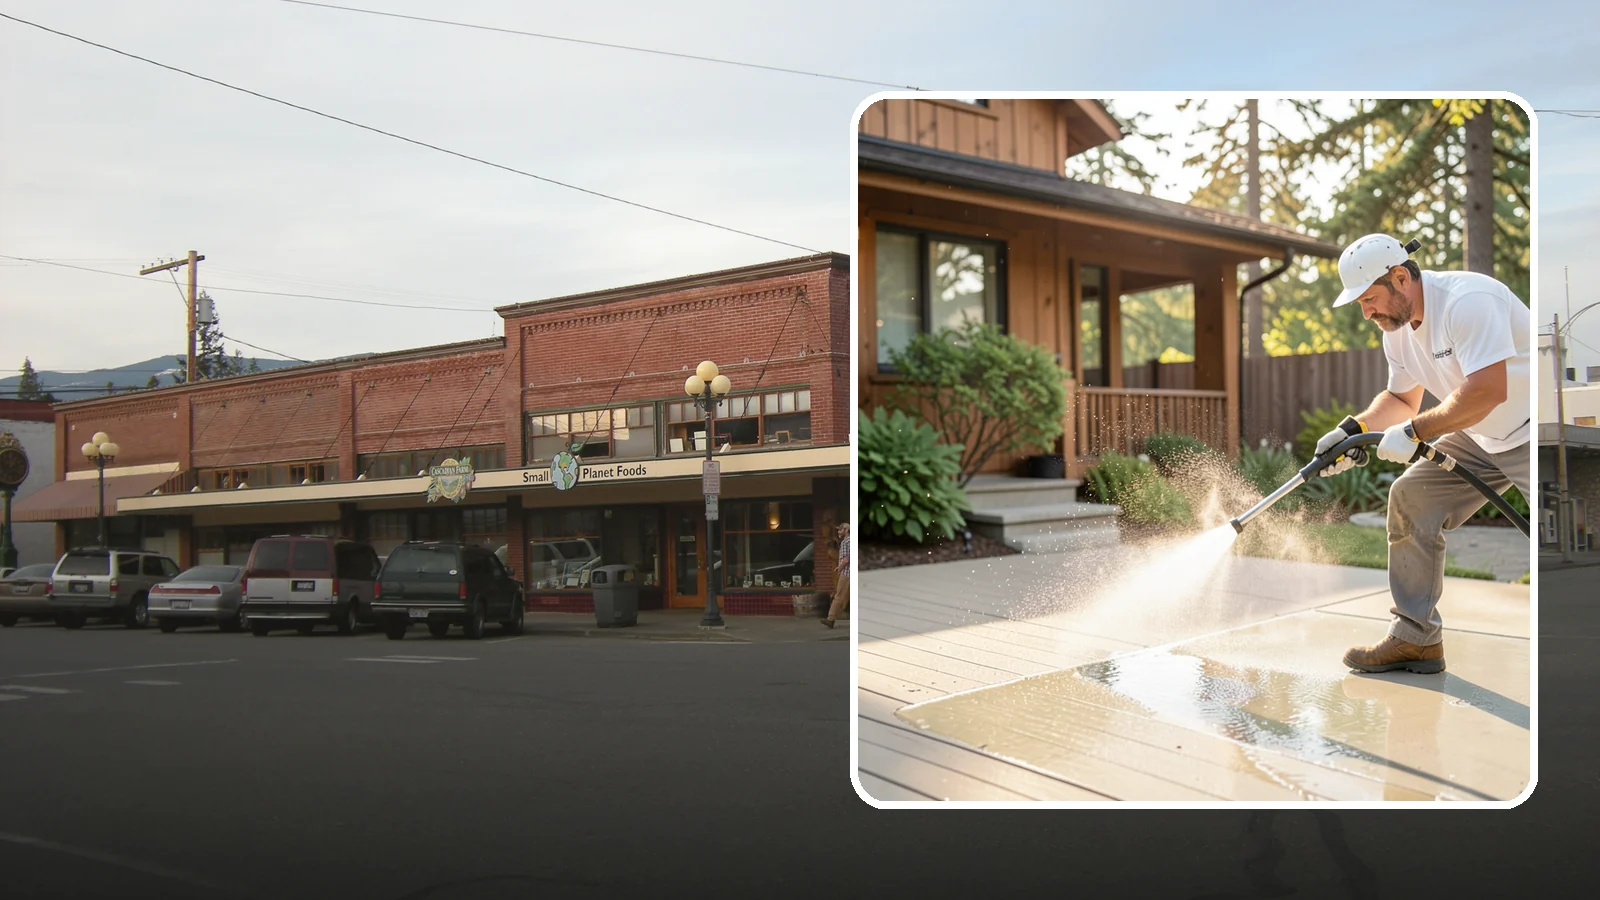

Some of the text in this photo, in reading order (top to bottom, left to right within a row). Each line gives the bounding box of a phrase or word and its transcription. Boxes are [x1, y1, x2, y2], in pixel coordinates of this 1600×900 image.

[523, 464, 647, 483] Small Planet Foods
